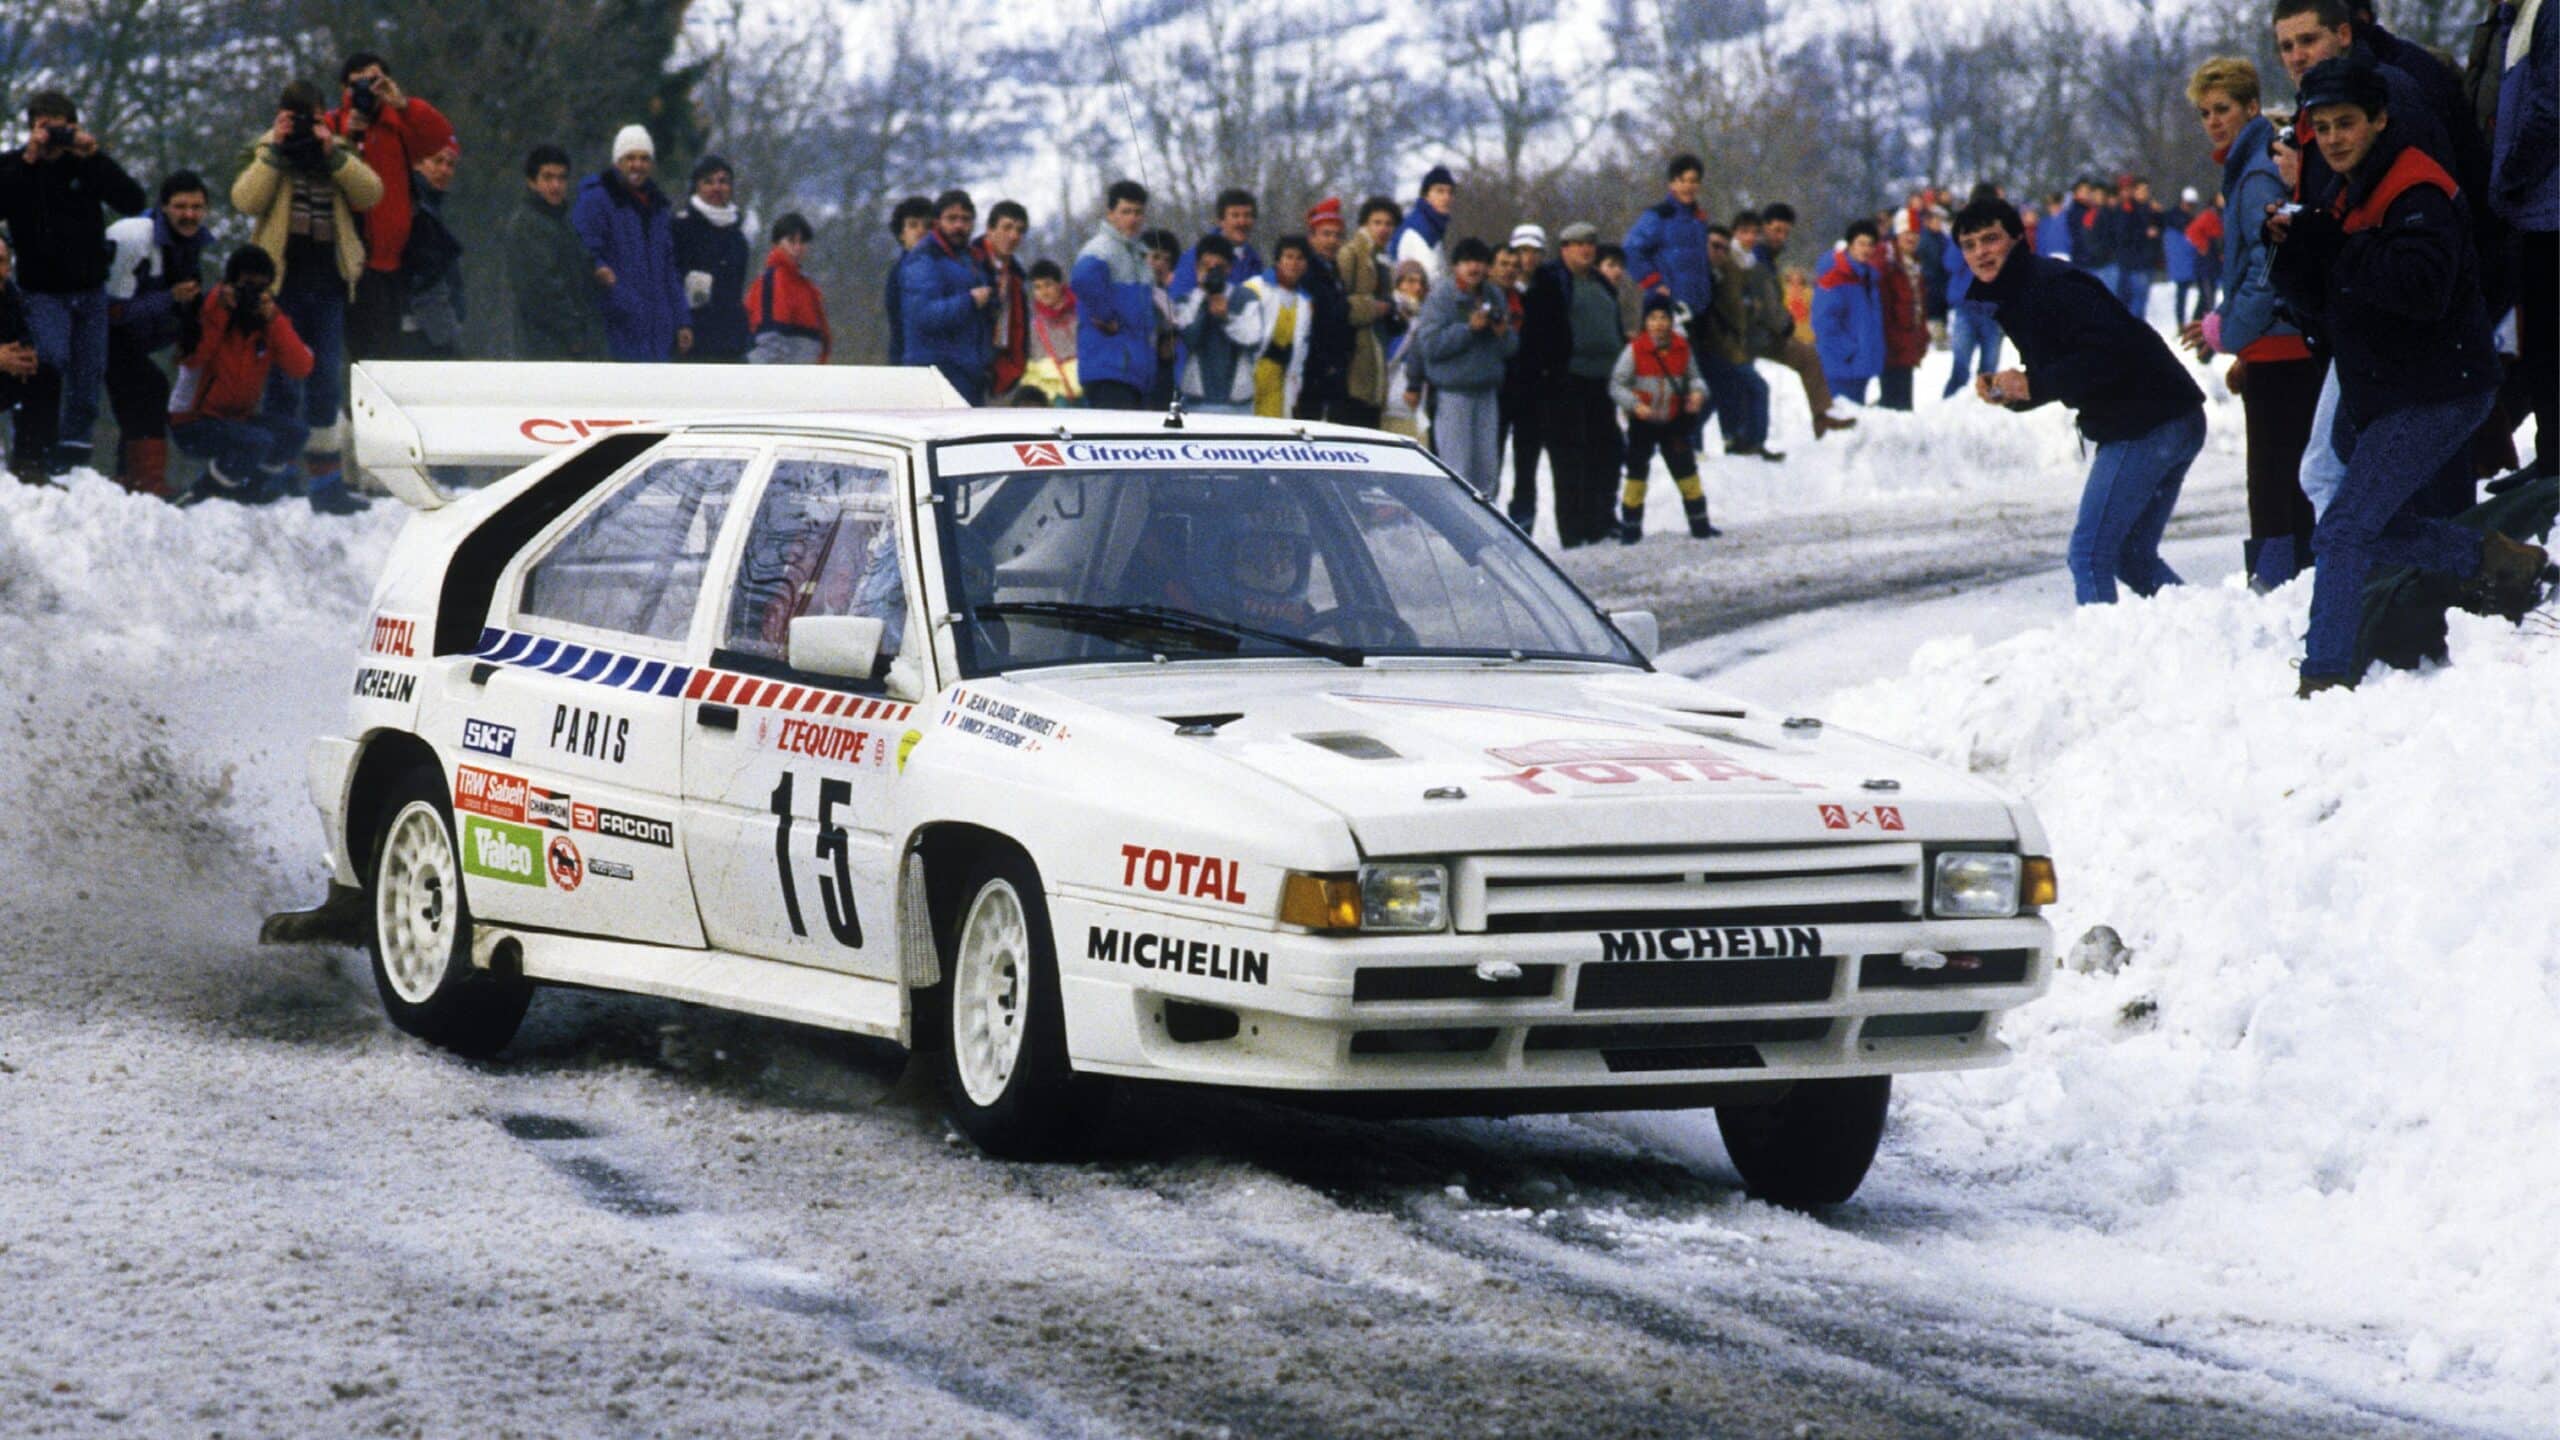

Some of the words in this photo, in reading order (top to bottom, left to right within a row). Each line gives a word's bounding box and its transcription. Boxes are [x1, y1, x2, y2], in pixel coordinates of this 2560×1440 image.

[519, 417, 660, 445] CI
[1067, 443, 1177, 462] Citroën
[1180, 443, 1371, 465] Compétitions
[370, 616, 416, 657] TOTAL
[966, 693, 990, 713] JEAN
[987, 699, 1020, 724] CLAUDE
[464, 721, 515, 753] SKF
[550, 703, 630, 764] PARIS
[458, 767, 488, 798] TRW
[486, 774, 526, 807] Sabelt
[1480, 760, 1827, 796] TOTA
[528, 799, 568, 819] CHAMPION
[600, 813, 671, 844] FACOM
[474, 826, 533, 876] Valeo
[770, 770, 864, 950] 15
[1120, 843, 1247, 905] TOTAL
[1087, 925, 1270, 986] MICHELIN
[1598, 927, 1823, 961] MICHELIN
